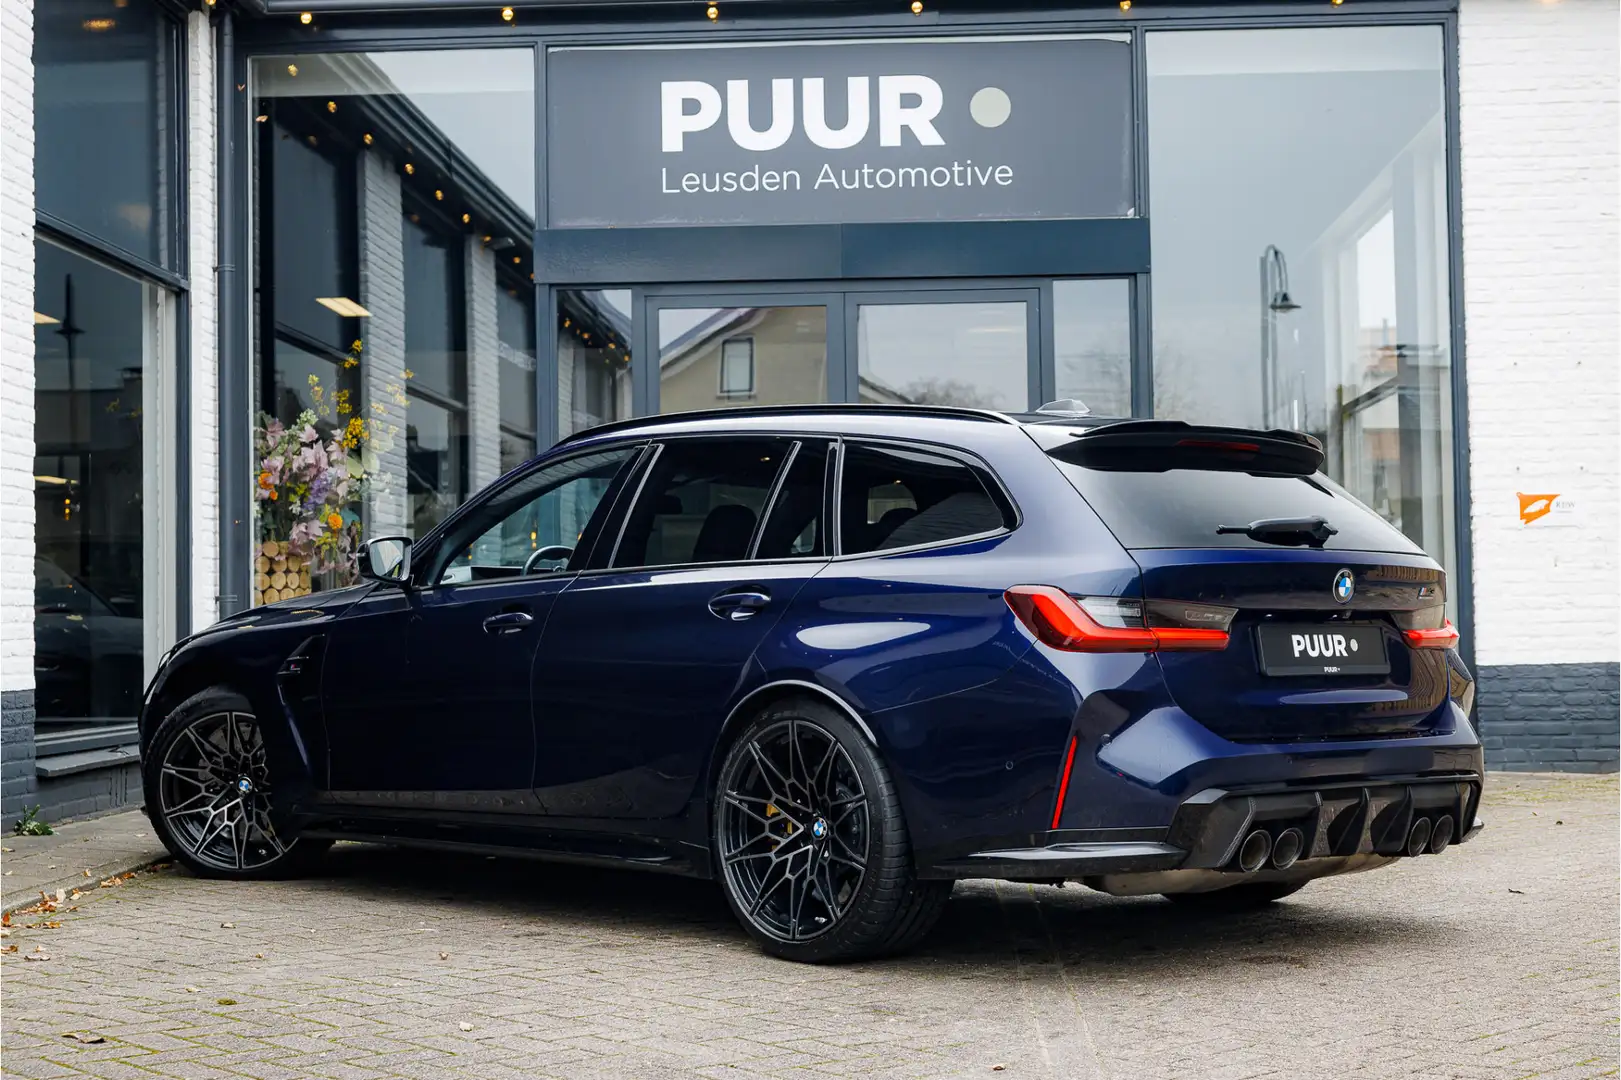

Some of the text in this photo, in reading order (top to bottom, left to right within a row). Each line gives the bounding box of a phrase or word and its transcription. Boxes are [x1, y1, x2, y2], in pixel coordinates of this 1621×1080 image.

[661, 74, 946, 153] PUUR
[661, 160, 1014, 194] Leusden Automotive
[1291, 634, 1349, 658] PUUR
